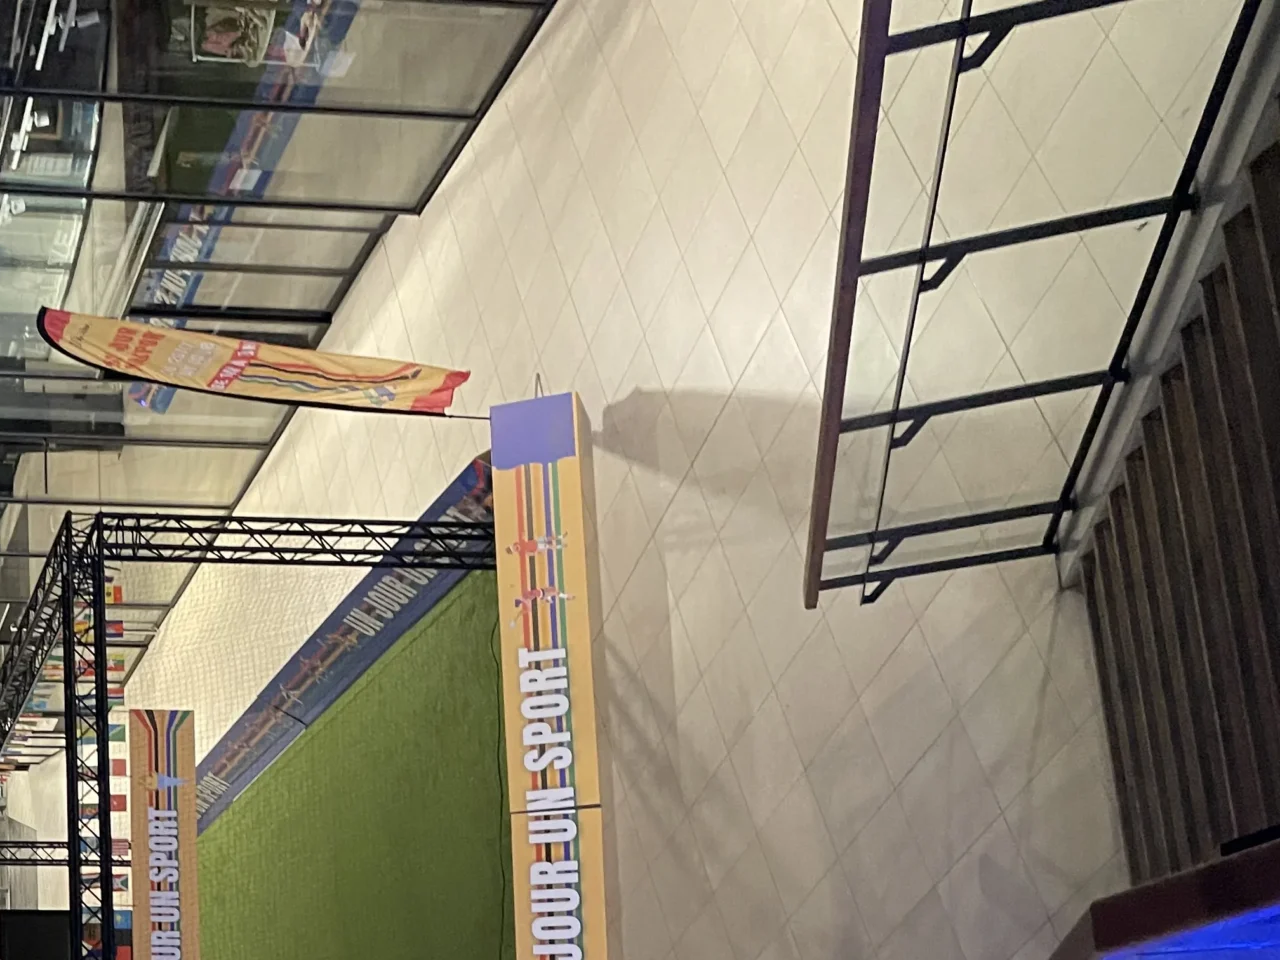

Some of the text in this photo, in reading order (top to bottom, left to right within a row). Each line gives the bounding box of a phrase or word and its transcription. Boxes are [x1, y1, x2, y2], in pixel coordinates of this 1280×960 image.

[363, 575, 417, 618] JOUR
[343, 608, 384, 636] UN
[517, 647, 573, 772] SPORT
[525, 787, 578, 843] UN
[147, 807, 179, 883] SPORT
[149, 891, 180, 923] UN
